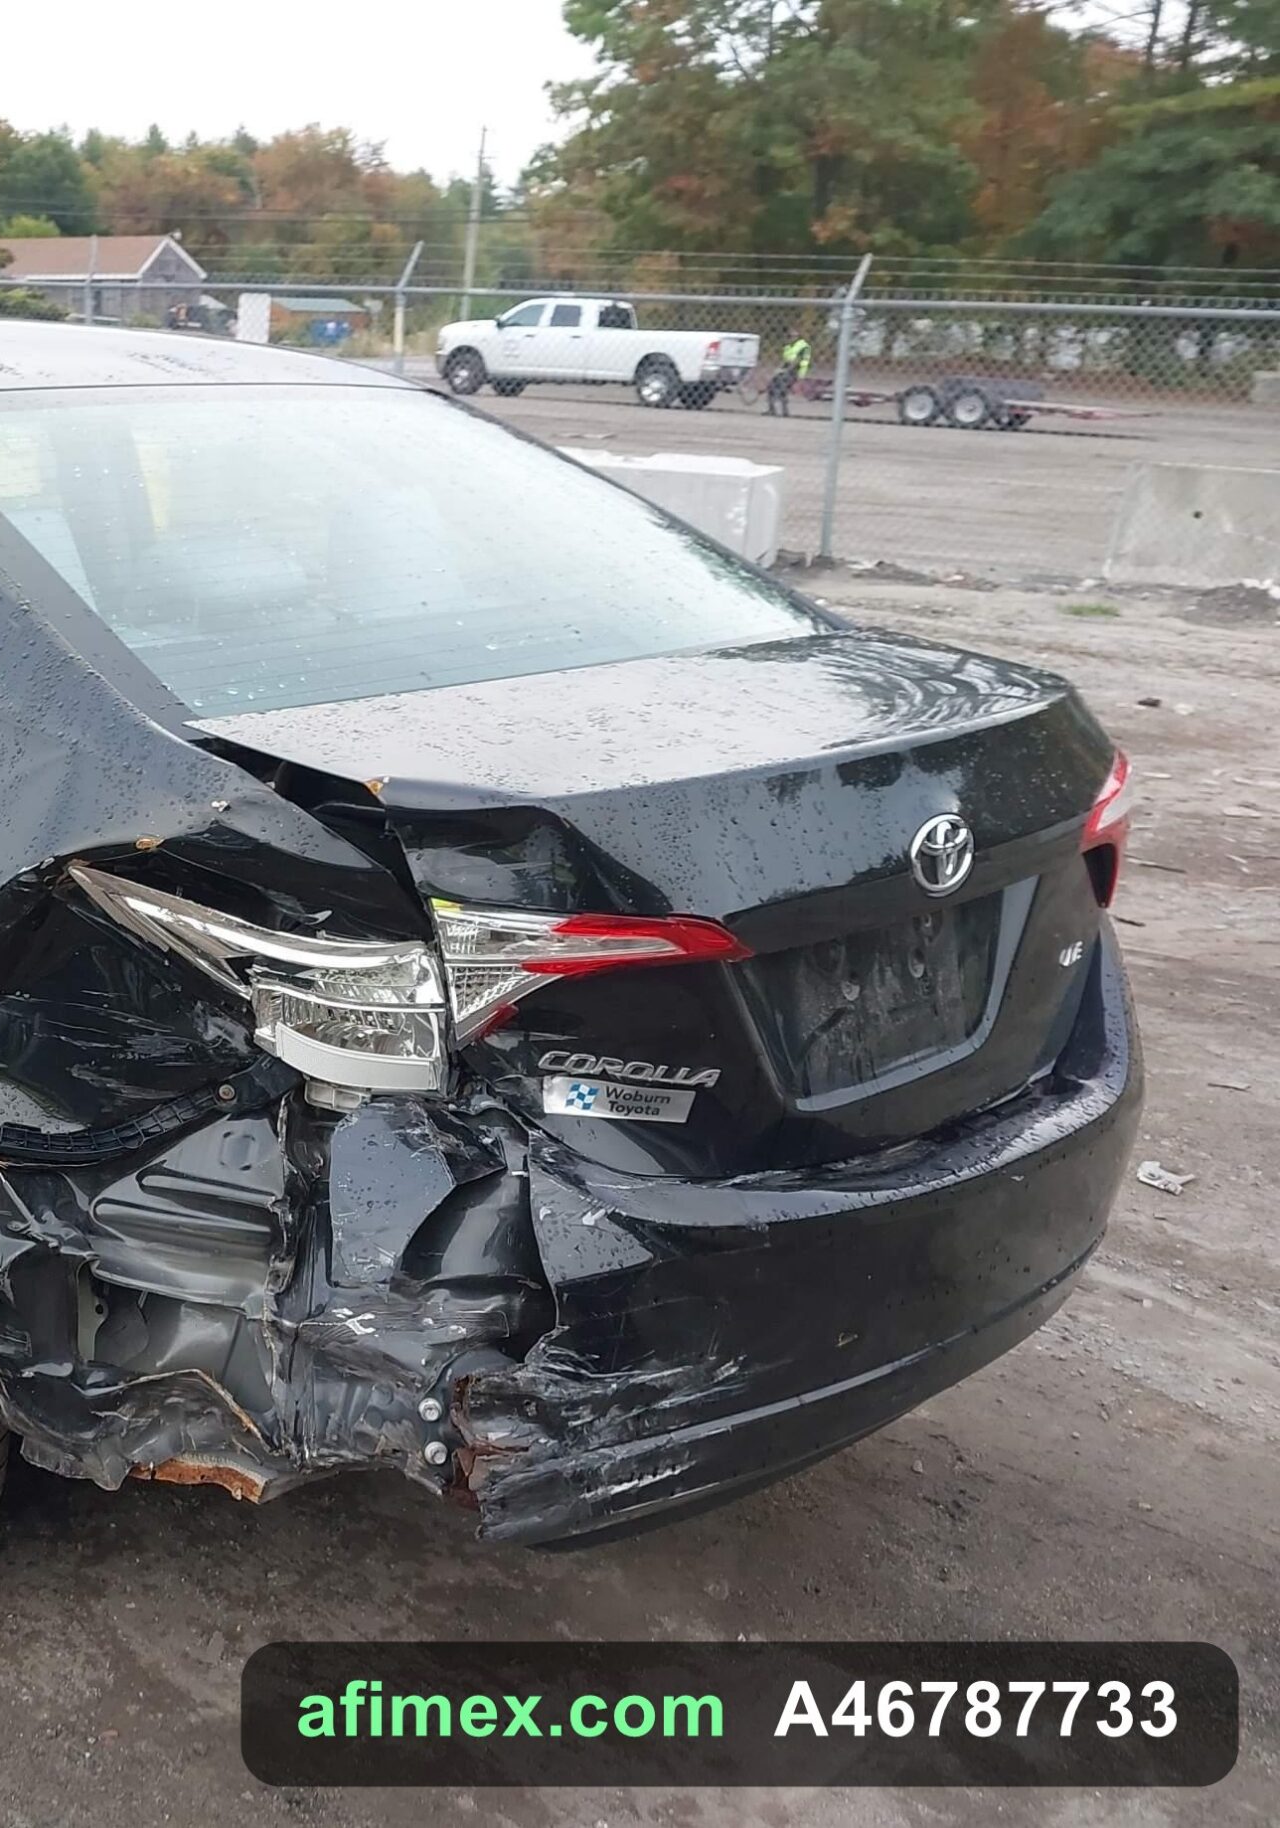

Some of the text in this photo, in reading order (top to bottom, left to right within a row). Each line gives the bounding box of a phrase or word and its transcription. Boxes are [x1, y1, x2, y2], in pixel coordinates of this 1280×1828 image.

[538, 1051, 721, 1087] COROLLA
[605, 1086, 671, 1105] Woburn
[607, 1101, 661, 1117] Toyota
